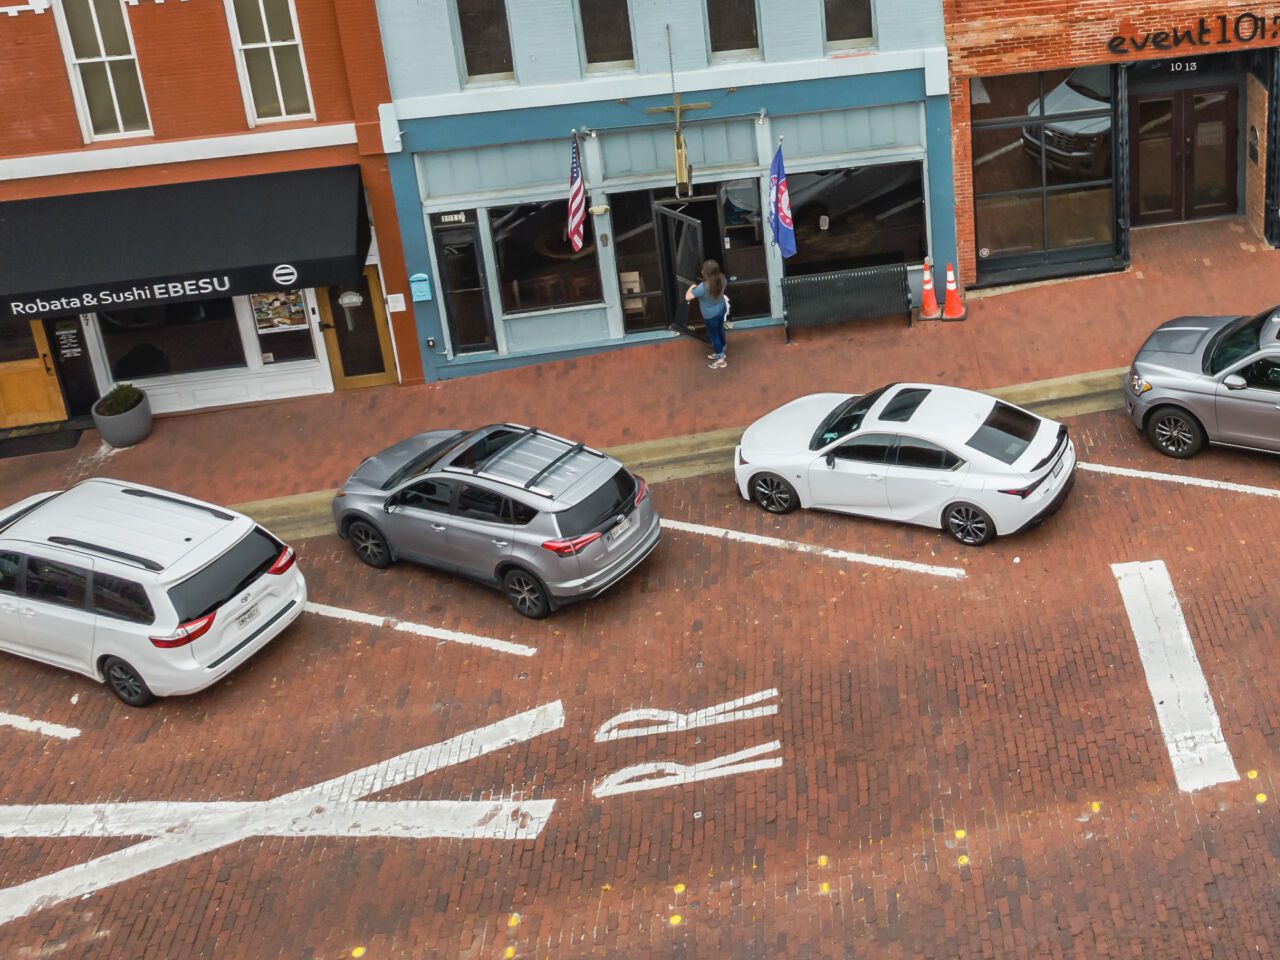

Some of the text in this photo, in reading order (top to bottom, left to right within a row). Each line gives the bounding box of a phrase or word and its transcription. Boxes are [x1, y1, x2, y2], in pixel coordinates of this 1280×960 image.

[11, 297, 81, 315] Robata
[101, 286, 151, 304] Sushi
[154, 276, 231, 298] EBESU
